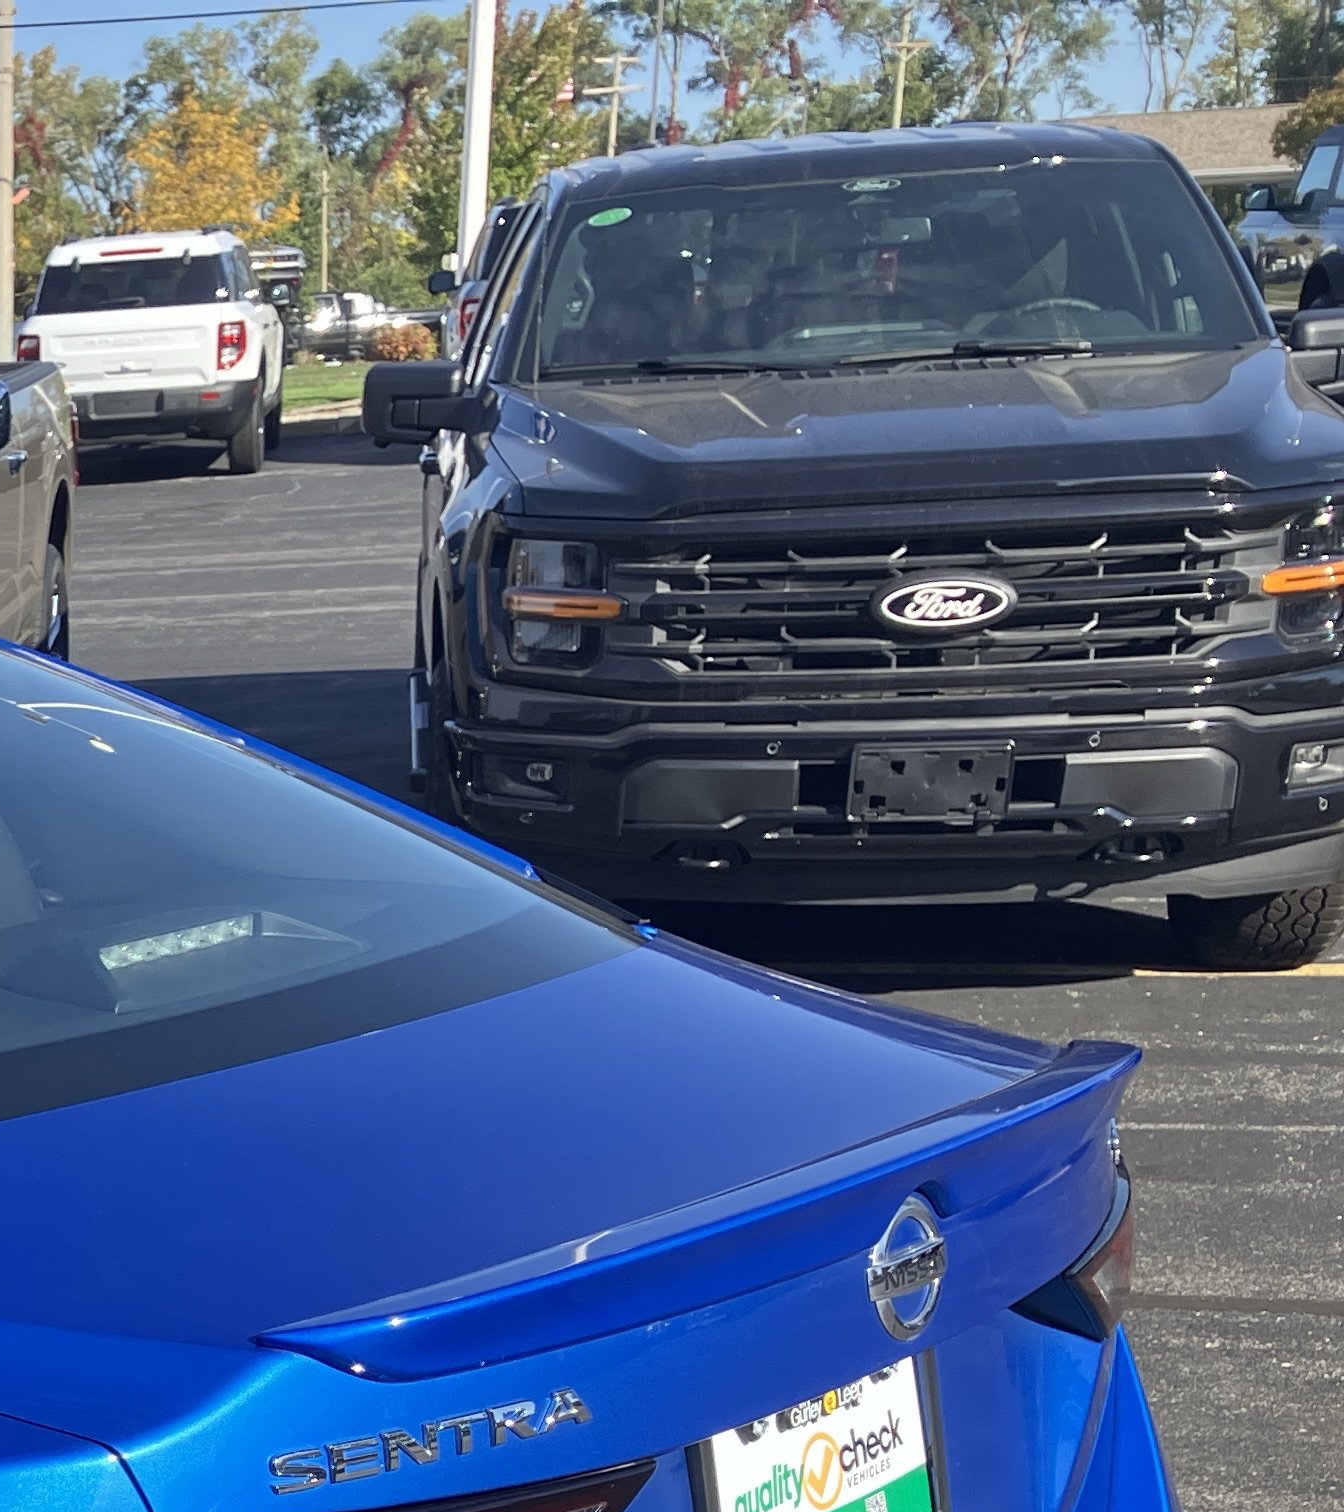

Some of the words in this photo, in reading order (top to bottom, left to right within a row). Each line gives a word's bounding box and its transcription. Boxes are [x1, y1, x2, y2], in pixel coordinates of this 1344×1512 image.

[904, 587, 985, 619] Ford
[268, 1388, 592, 1495] SENTRA
[839, 1409, 904, 1472] check
[846, 1458, 891, 1488] VEHICLES
